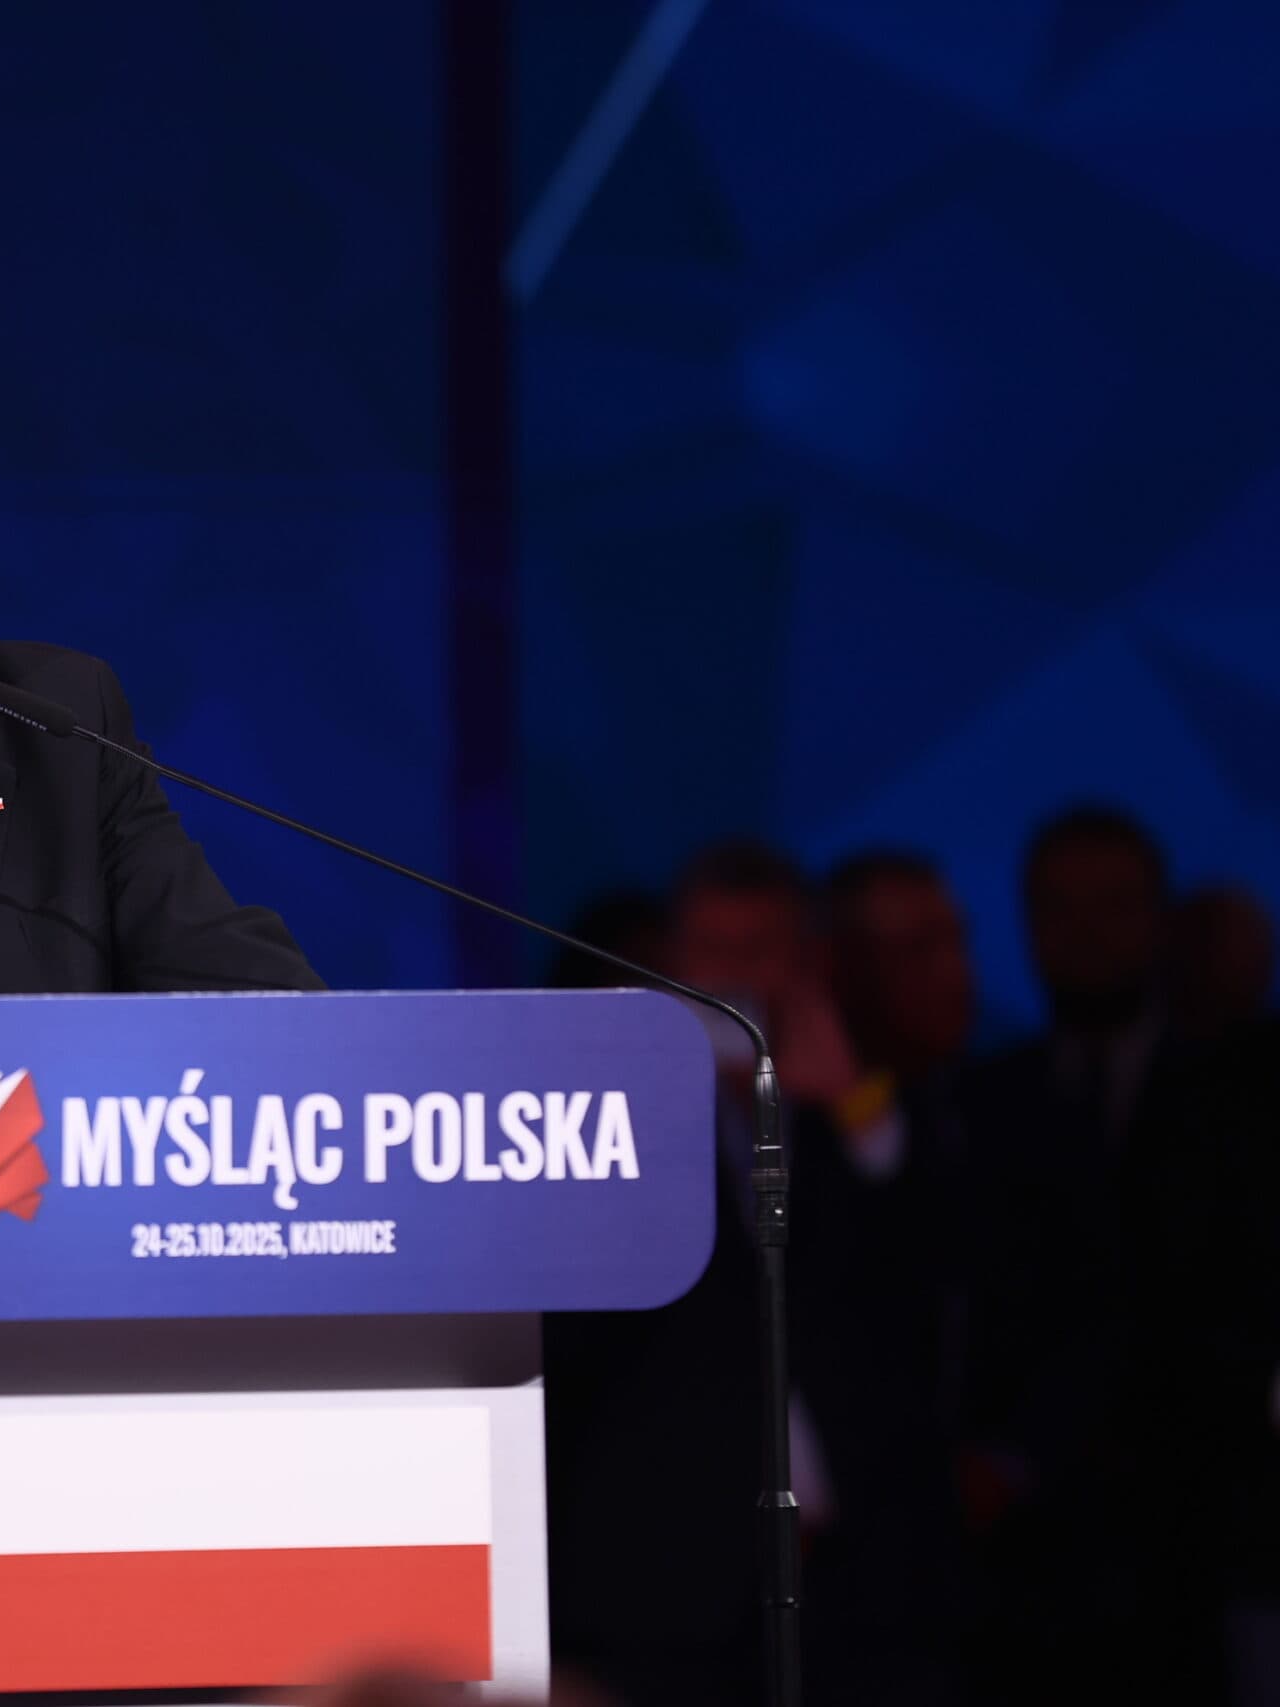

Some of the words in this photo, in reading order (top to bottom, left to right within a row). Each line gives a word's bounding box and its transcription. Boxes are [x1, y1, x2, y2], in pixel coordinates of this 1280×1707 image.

[61, 1068, 343, 1210] MYŚLĄC
[364, 1091, 639, 1183] POLSKA
[131, 1220, 288, 1259] 24-25.10.2025,
[289, 1219, 396, 1256] KATOWICE
